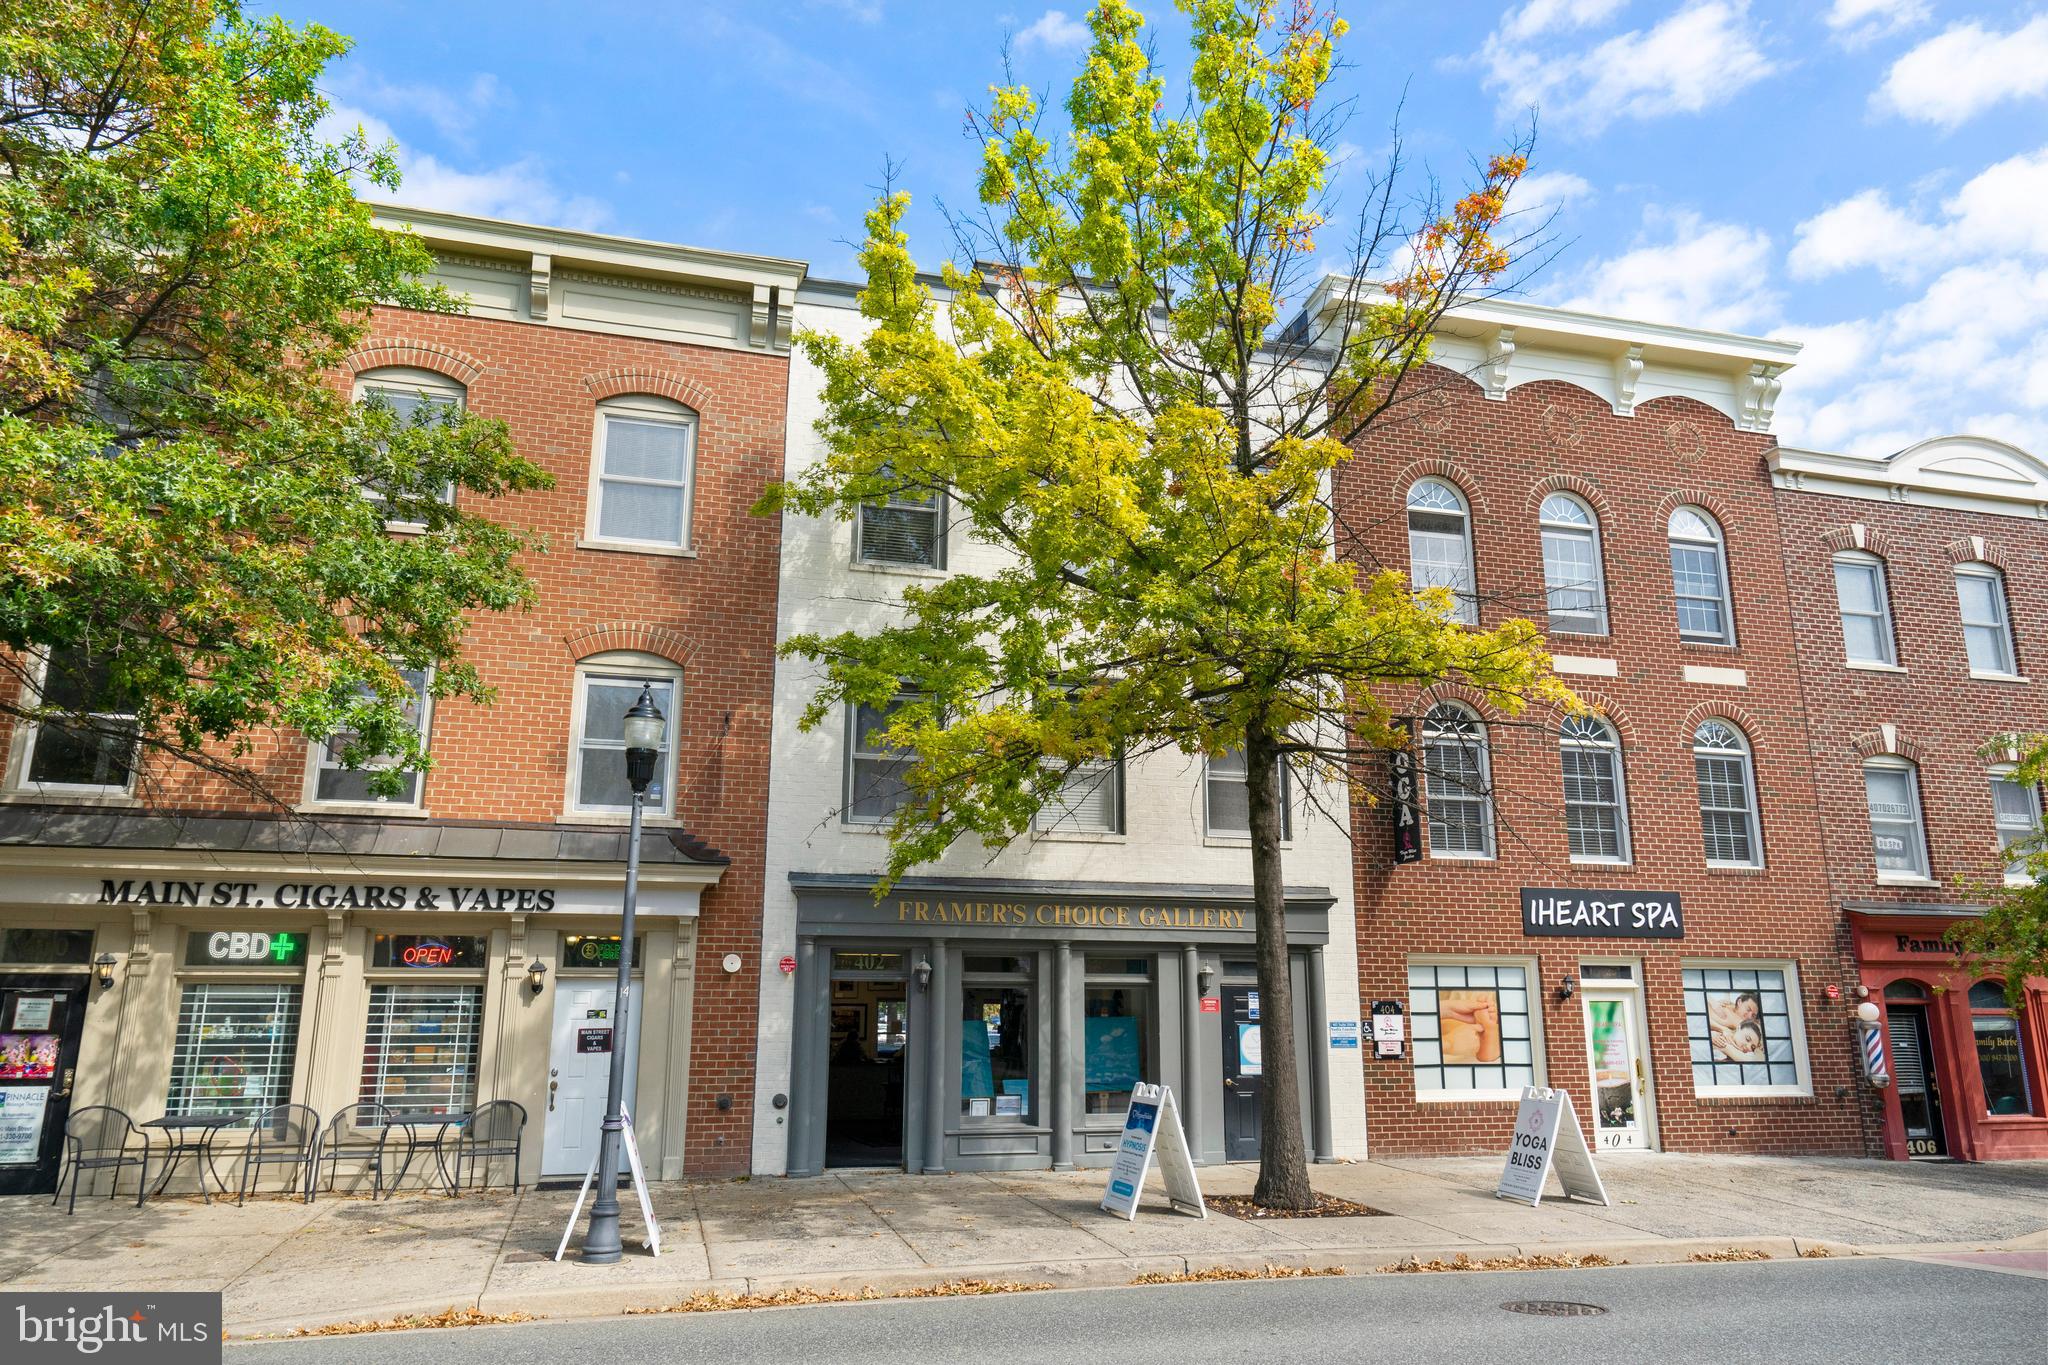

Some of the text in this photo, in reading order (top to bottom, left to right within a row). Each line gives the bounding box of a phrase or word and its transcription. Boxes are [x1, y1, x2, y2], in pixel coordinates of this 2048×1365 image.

[97, 879, 556, 912] MAIN ST. CIGARS & VAPES
[898, 901, 1247, 929] FRAMER'S CHOICE GALLERY
[1530, 897, 1679, 929] IHEART SPA
[403, 947, 452, 964] OPEN
[855, 956, 885, 970] 402
[1380, 1005, 1395, 1014] 404
[6, 1092, 45, 1101] PINNACLE
[1122, 1139, 1147, 1152] HYPNOSIS
[1515, 1132, 1547, 1151] YOGA
[1906, 1139, 1937, 1154] 406
[1510, 1151, 1542, 1170] BLISS
